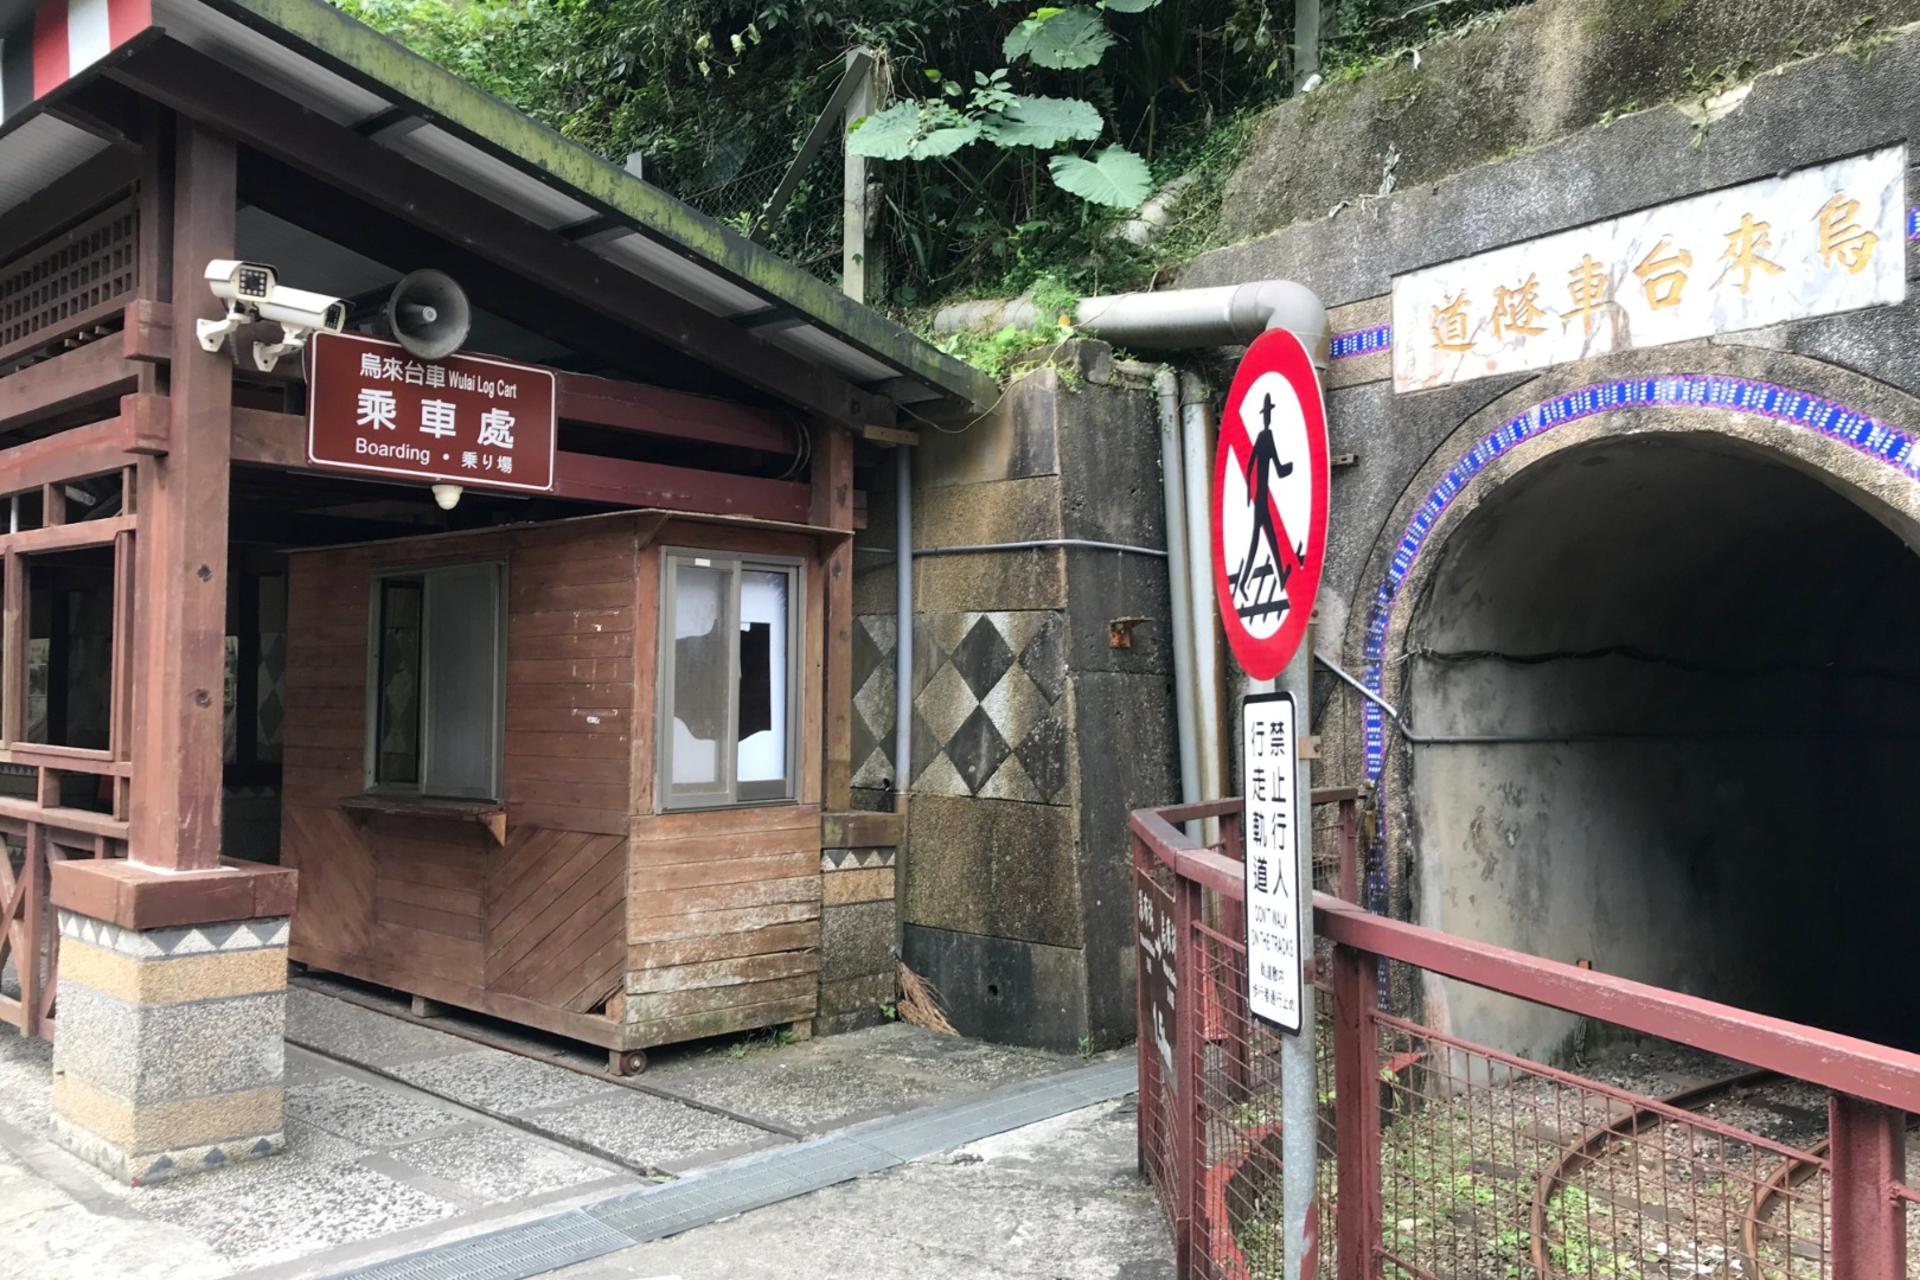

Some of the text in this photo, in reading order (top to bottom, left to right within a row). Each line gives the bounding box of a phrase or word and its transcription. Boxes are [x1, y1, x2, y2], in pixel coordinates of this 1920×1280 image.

[449, 370, 476, 391] Wulai
[477, 376, 495, 398] Log
[497, 379, 517, 399] Cart
[356, 437, 431, 465] Boarding
[1270, 721, 1288, 898] 禁止行人
